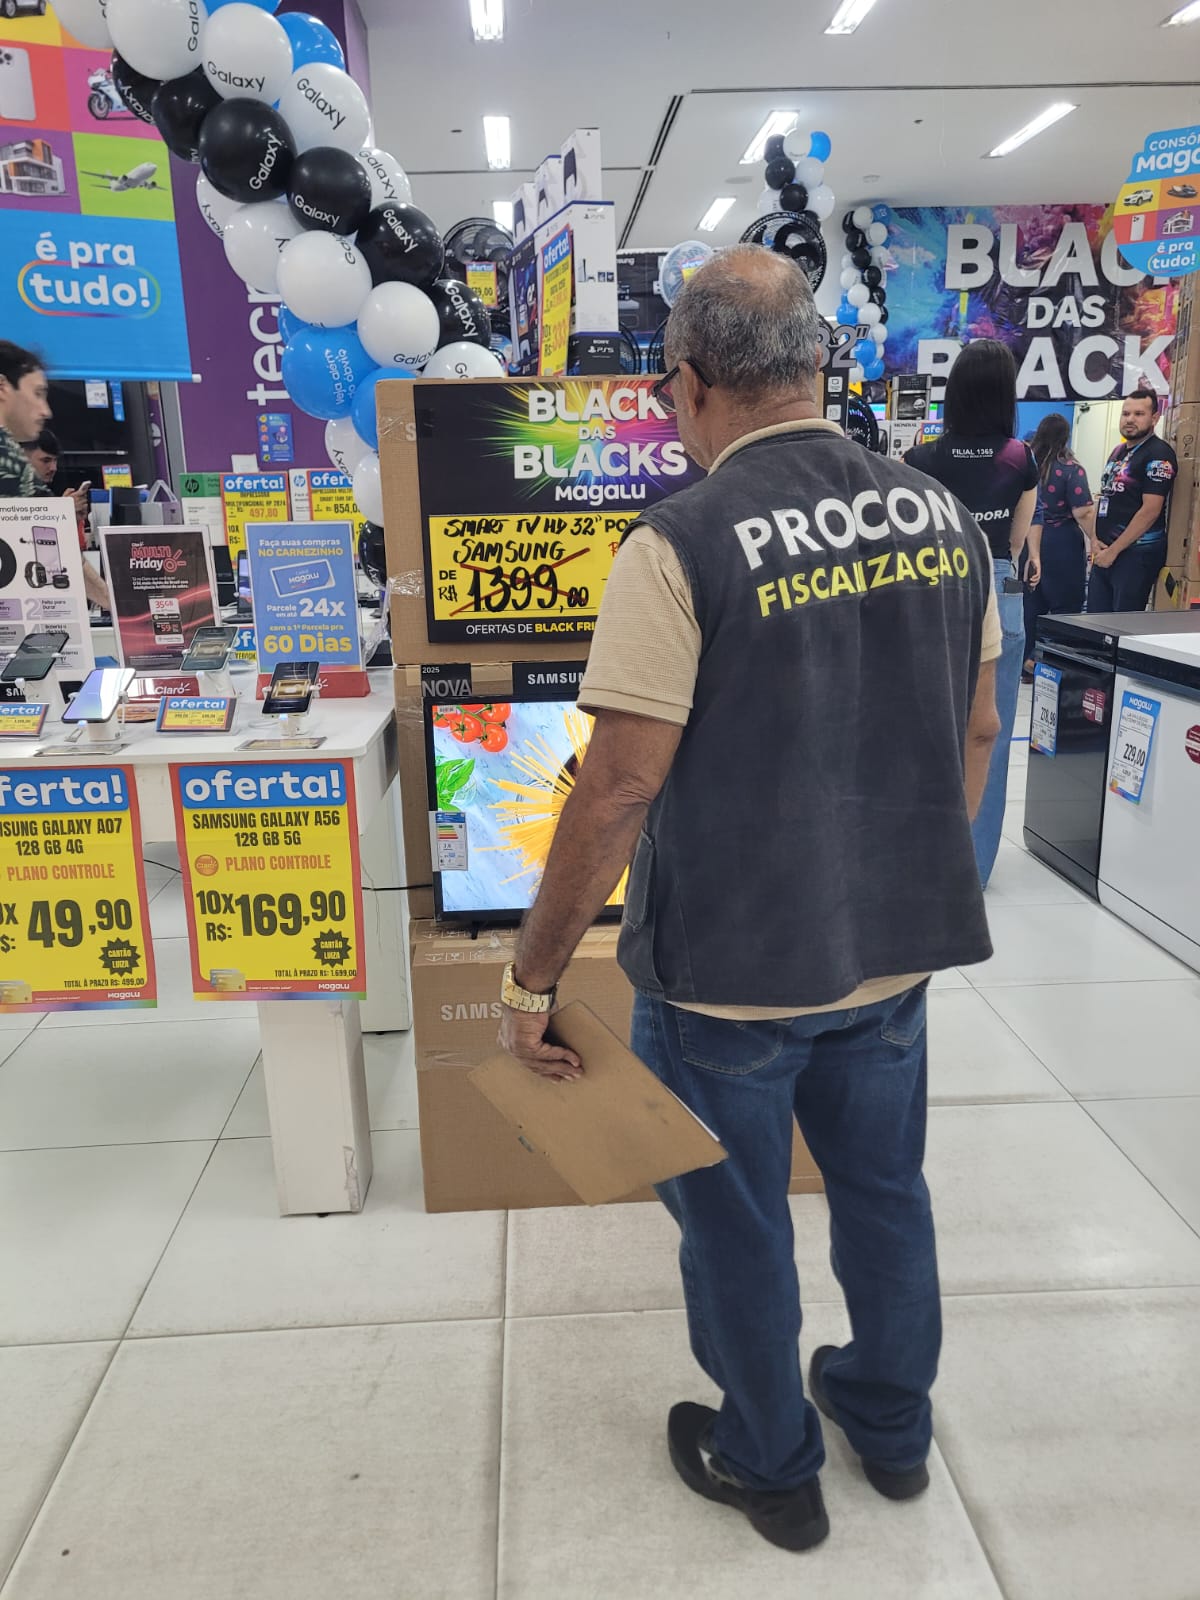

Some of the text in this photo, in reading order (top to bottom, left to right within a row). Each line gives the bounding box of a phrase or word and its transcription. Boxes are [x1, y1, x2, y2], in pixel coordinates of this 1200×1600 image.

[187, 0, 200, 51] Gala
[207, 61, 265, 92] Galaxy
[120, 84, 157, 127] alaxy
[296, 78, 347, 131] Galaxy
[1149, 132, 1200, 152] CONSÓ
[249, 127, 282, 191] Galaxy
[359, 150, 399, 201] Galaxy
[294, 195, 340, 228] Galaxy
[383, 208, 419, 253] Galaxy
[35, 232, 136, 269] é pra
[945, 221, 1171, 289] BLAC
[1156, 241, 1194, 255] é pra
[1152, 252, 1197, 270] tudo!
[29, 277, 151, 308] tudo!
[445, 285, 479, 338] Galaxy
[1027, 294, 1106, 329] DAS
[917, 334, 1177, 402] BACK
[528, 387, 668, 422] BLACK
[578, 425, 616, 441] DAS
[924, 424, 942, 434] ofe
[514, 441, 688, 480] BLACKS
[225, 474, 284, 491] oferta!
[555, 484, 646, 507] Magalu
[1, 512, 19, 521] você
[33, 513, 60, 523] Galaxy
[30, 506, 48, 515] para
[333, 503, 360, 514] 854,0
[444, 518, 511, 538] SMART
[515, 515, 544, 535] TV
[734, 487, 963, 570] PROCON
[258, 547, 344, 557] NO CARNEZINHO
[259, 539, 280, 549] Faça
[302, 538, 341, 549] compras
[453, 539, 566, 565] SAMSUNG
[130, 557, 163, 571] Friday
[288, 573, 320, 585] Magalu
[439, 569, 457, 580] DE
[266, 597, 347, 618] Parcele 24x
[466, 621, 597, 635] OFERTAS DE BLACK FRI
[263, 634, 293, 653] 60
[299, 632, 352, 653] Dias
[155, 684, 185, 695] Claro
[421, 679, 472, 698] NOVA
[170, 699, 225, 709] oferta!
[185, 769, 341, 802] oferta!
[42, 819, 92, 836] GALAXY
[97, 817, 122, 834] A07
[192, 810, 341, 830] SAMSUNG GALAXY A56
[16, 839, 84, 856] 128 GB 4G
[234, 831, 302, 847] 128 GB 5G
[7, 863, 115, 882] PLANO CONTROLE
[225, 855, 266, 872] PLANO
[269, 854, 332, 871] CONTROLE
[28, 898, 133, 949] 49,90
[235, 890, 346, 937] 169,90
[206, 922, 233, 943] R$:
[64, 980, 82, 988] TOTAL
[90, 978, 109, 987] PRAZO
[275, 970, 292, 978] TOTAL
[299, 969, 318, 977] PRAZO
[107, 991, 141, 1000] Magalu
[318, 983, 350, 991] Magalu
[441, 1002, 502, 1021] SAMS
